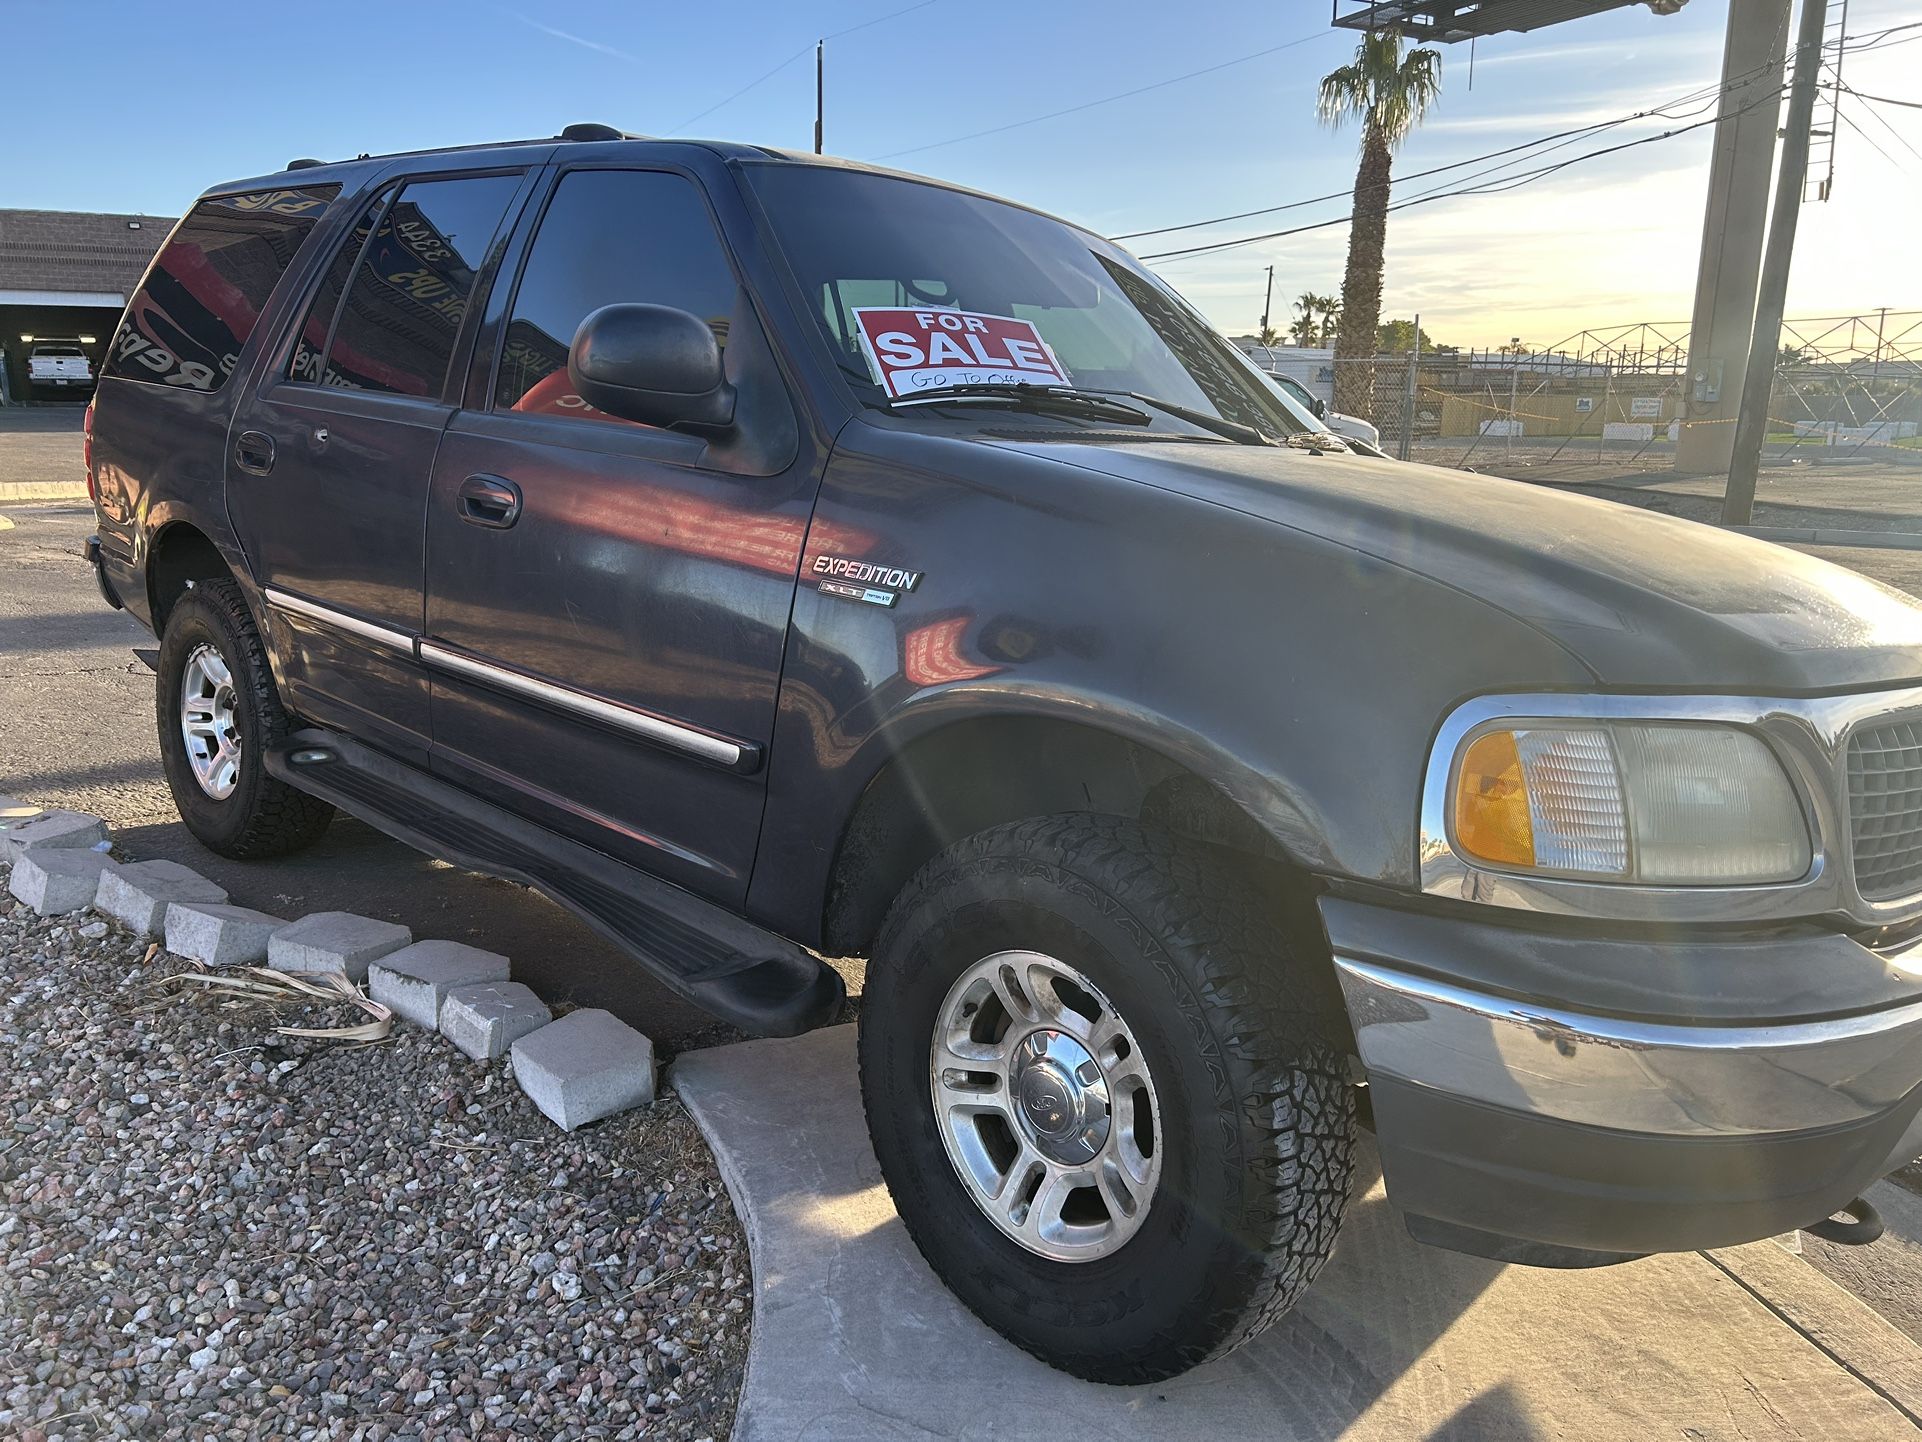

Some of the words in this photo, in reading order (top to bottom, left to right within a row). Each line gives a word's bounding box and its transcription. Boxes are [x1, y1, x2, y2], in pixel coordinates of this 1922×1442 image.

[915, 313, 989, 334] FOR
[875, 331, 1053, 372] SALE
[813, 555, 918, 590] EXPEDITION
[825, 583, 862, 596] XLT
